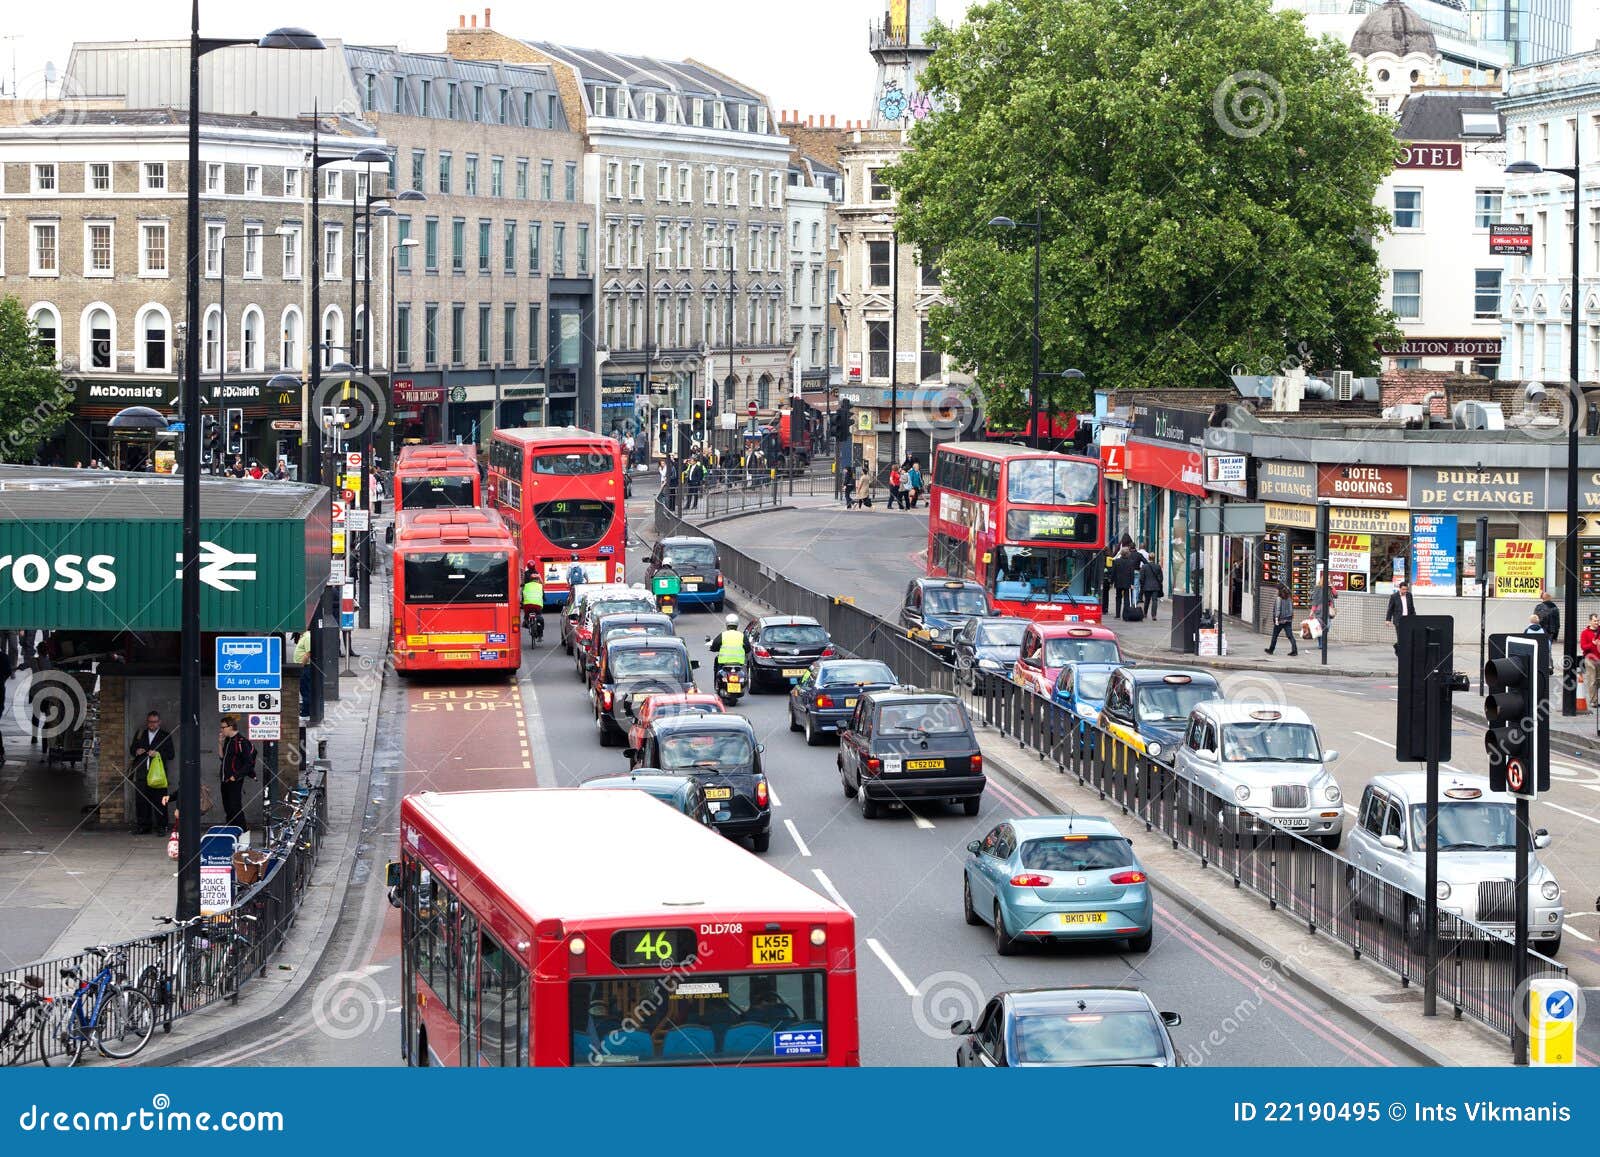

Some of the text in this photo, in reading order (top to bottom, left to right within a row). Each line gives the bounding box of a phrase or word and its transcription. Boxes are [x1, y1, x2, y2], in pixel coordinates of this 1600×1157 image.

[1394, 148, 1460, 166] OTEL
[90, 386, 162, 397] McDonald's
[1268, 464, 1305, 478] BUREAU
[1437, 471, 1520, 485] BUREAU
[1260, 480, 1313, 498] DE CHANGE
[1334, 480, 1393, 494] BOOKINGS
[1422, 490, 1534, 505] DE CHANGE
[556, 502, 566, 512] 91
[1276, 508, 1311, 523] COMMISSION
[1335, 508, 1390, 520] TOURIST
[1414, 516, 1444, 524] TOURIST
[1058, 516, 1074, 527] 390
[1329, 520, 1407, 532] NFORMATION
[1414, 524, 1437, 532] OFFICE
[1505, 542, 1534, 558] DHL
[448, 554, 464, 566] 73
[1498, 577, 1540, 588] SIM CARDS
[1035, 603, 1062, 611] Metroline
[422, 690, 500, 700] BUS
[410, 702, 513, 712] STOP
[700, 923, 742, 935] DLD708
[634, 931, 672, 960] 46
[756, 936, 789, 950] LK55
[760, 950, 785, 962] KMG
